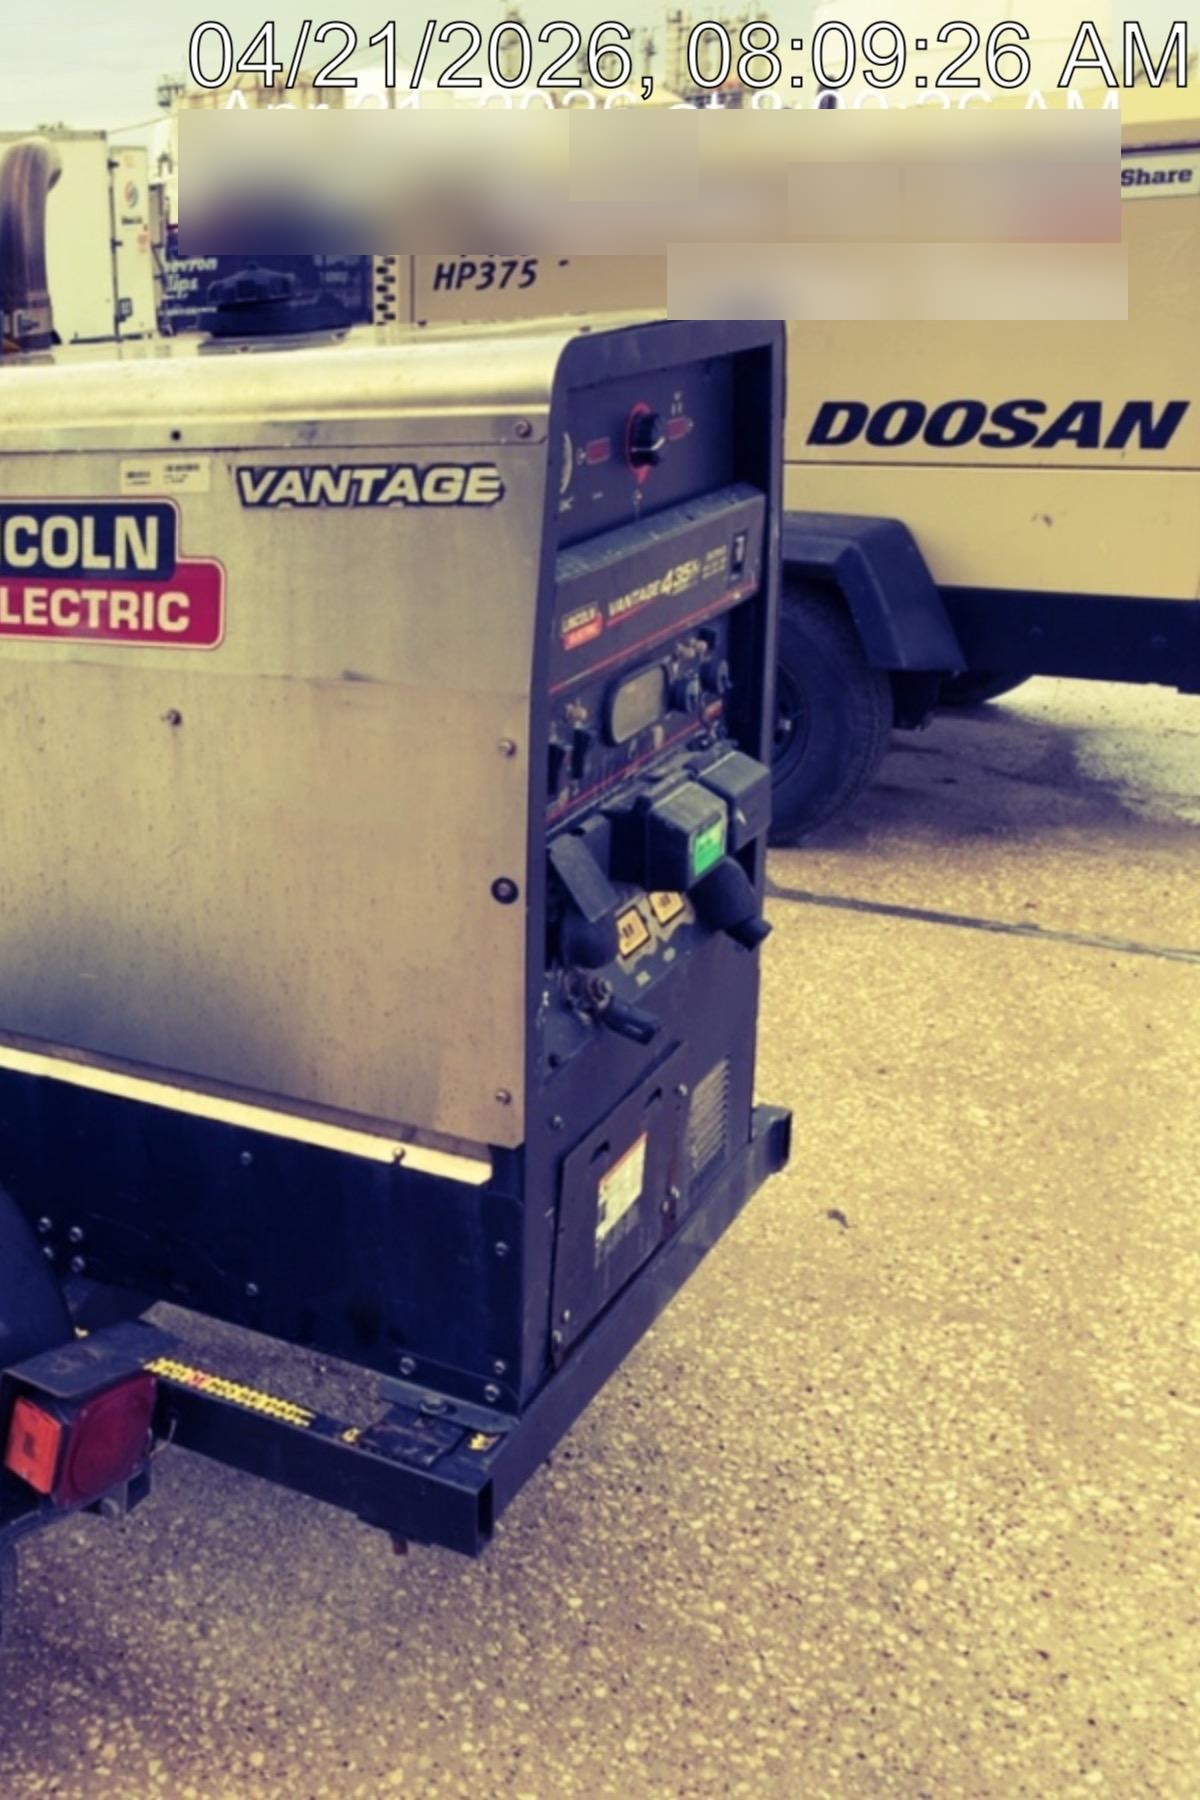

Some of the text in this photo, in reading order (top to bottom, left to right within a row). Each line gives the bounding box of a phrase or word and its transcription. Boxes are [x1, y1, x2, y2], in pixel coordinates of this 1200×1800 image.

[433, 259, 538, 290] HP375
[805, 399, 1192, 450] DOOSAN
[234, 463, 504, 507] VANTAGE
